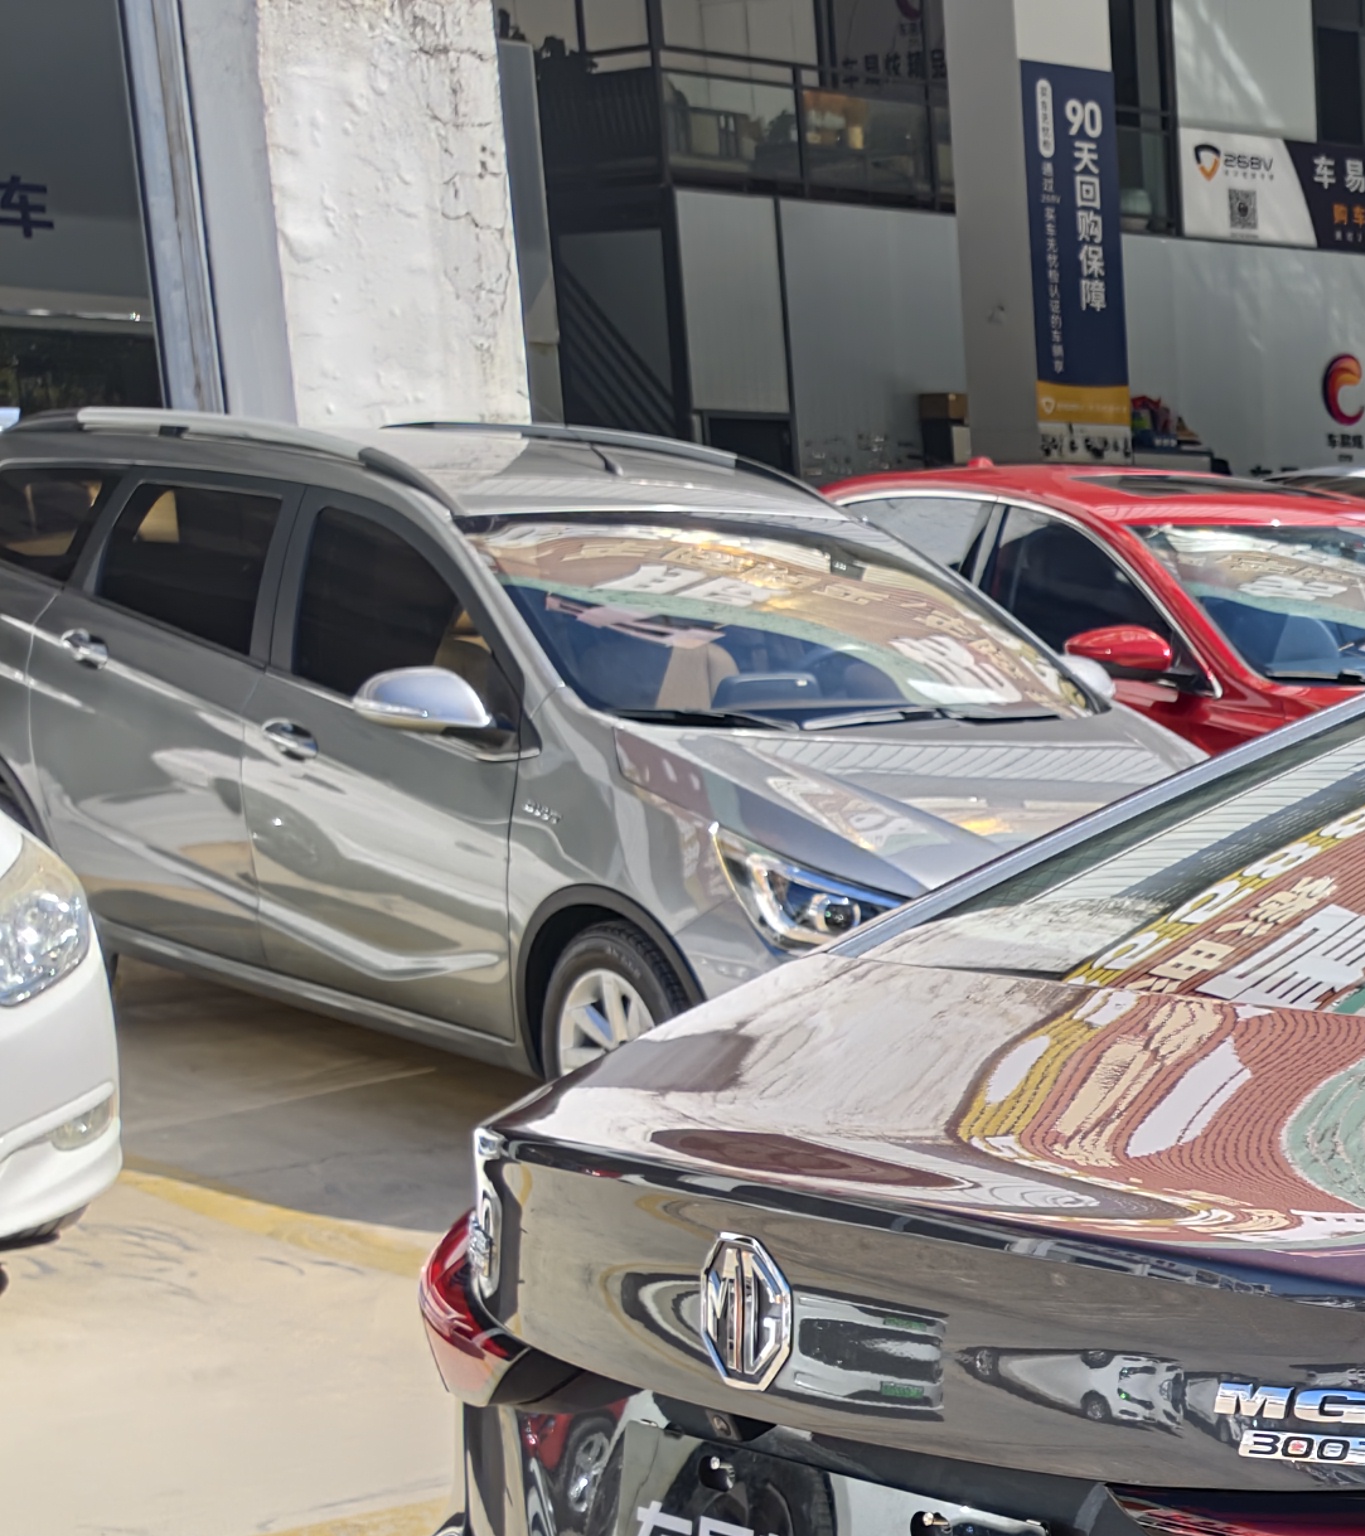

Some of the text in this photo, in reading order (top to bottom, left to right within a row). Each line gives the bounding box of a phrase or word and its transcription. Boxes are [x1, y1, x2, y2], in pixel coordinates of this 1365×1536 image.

[1065, 98, 1107, 312] 90天回购保障
[1223, 153, 1273, 172] 268V
